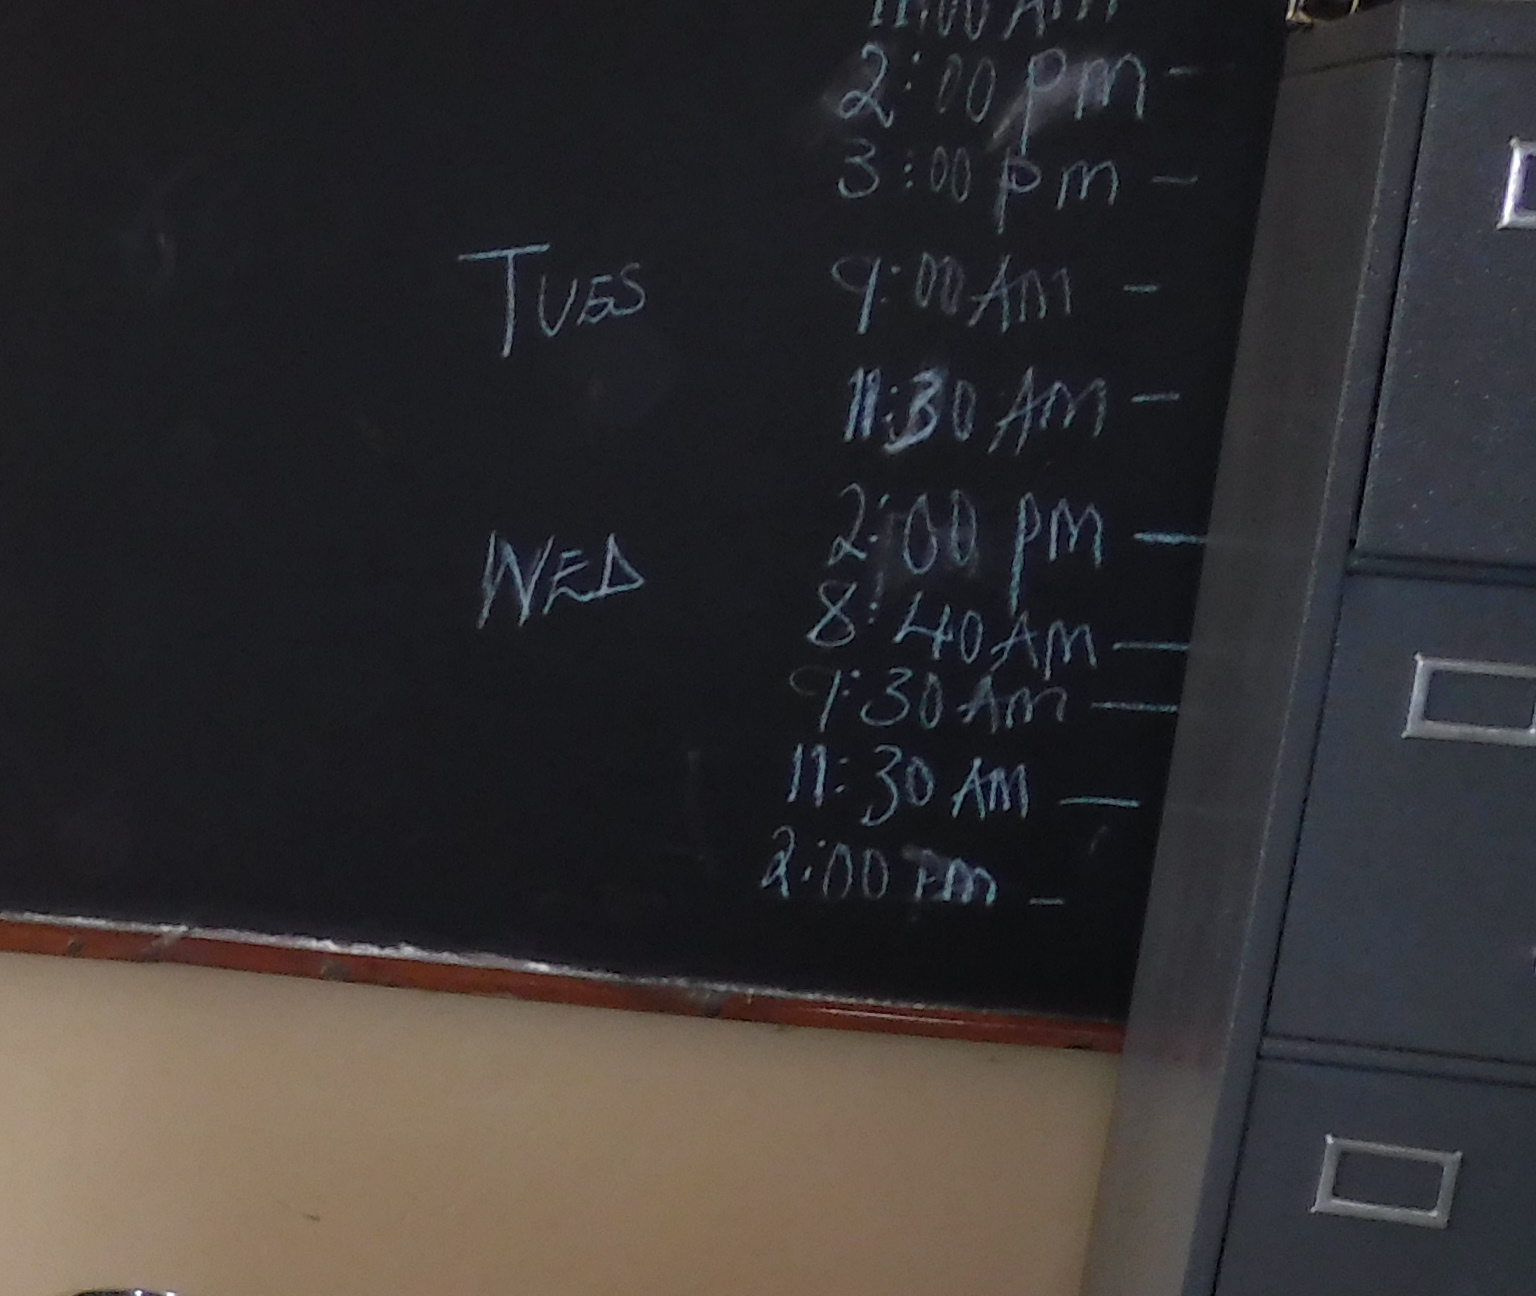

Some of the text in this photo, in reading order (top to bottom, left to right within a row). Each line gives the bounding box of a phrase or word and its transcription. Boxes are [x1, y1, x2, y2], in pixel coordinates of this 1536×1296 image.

[837, 41, 998, 128] 2:00
[837, 138, 972, 203] 3:00
[842, 364, 978, 456] 11:30
[827, 482, 978, 576] 2:00
